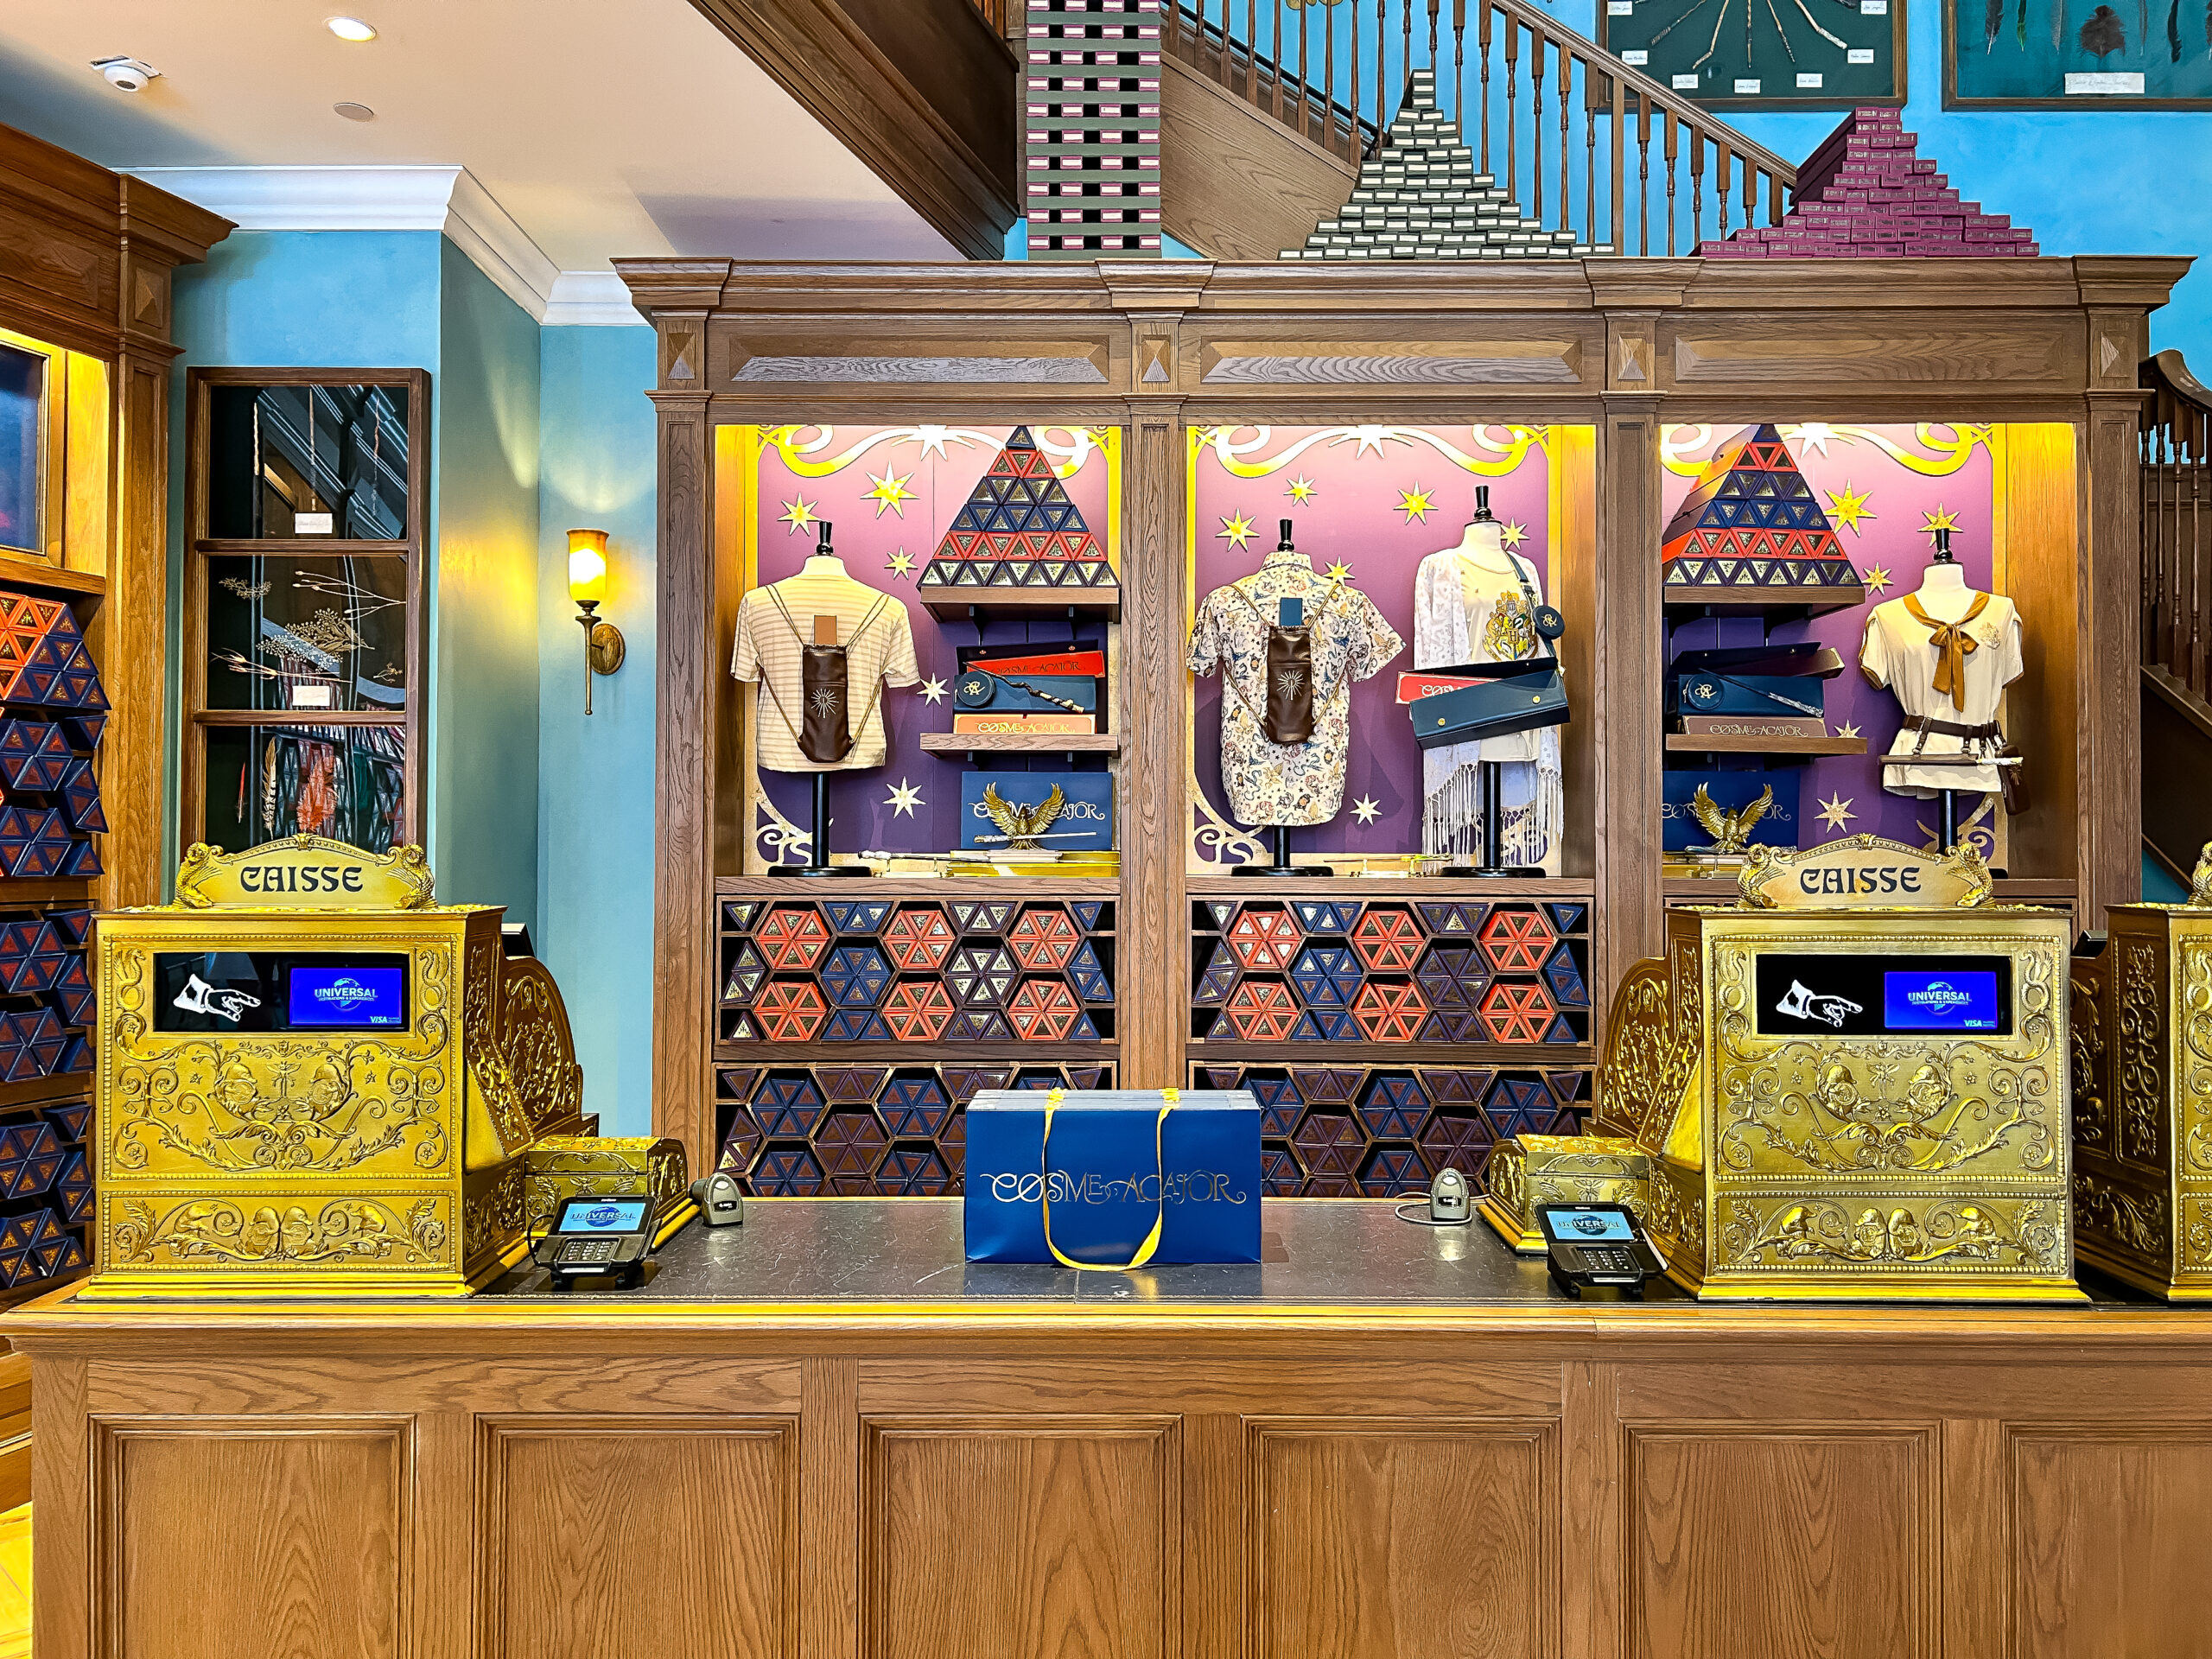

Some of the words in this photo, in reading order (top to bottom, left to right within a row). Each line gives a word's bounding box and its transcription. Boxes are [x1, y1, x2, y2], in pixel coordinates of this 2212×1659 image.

[240, 867, 364, 892] CAISSE
[1800, 868, 1921, 893] CAISSE
[315, 988, 378, 998] UNIVERSAL
[1908, 991, 1972, 1002] UNIVERSAL
